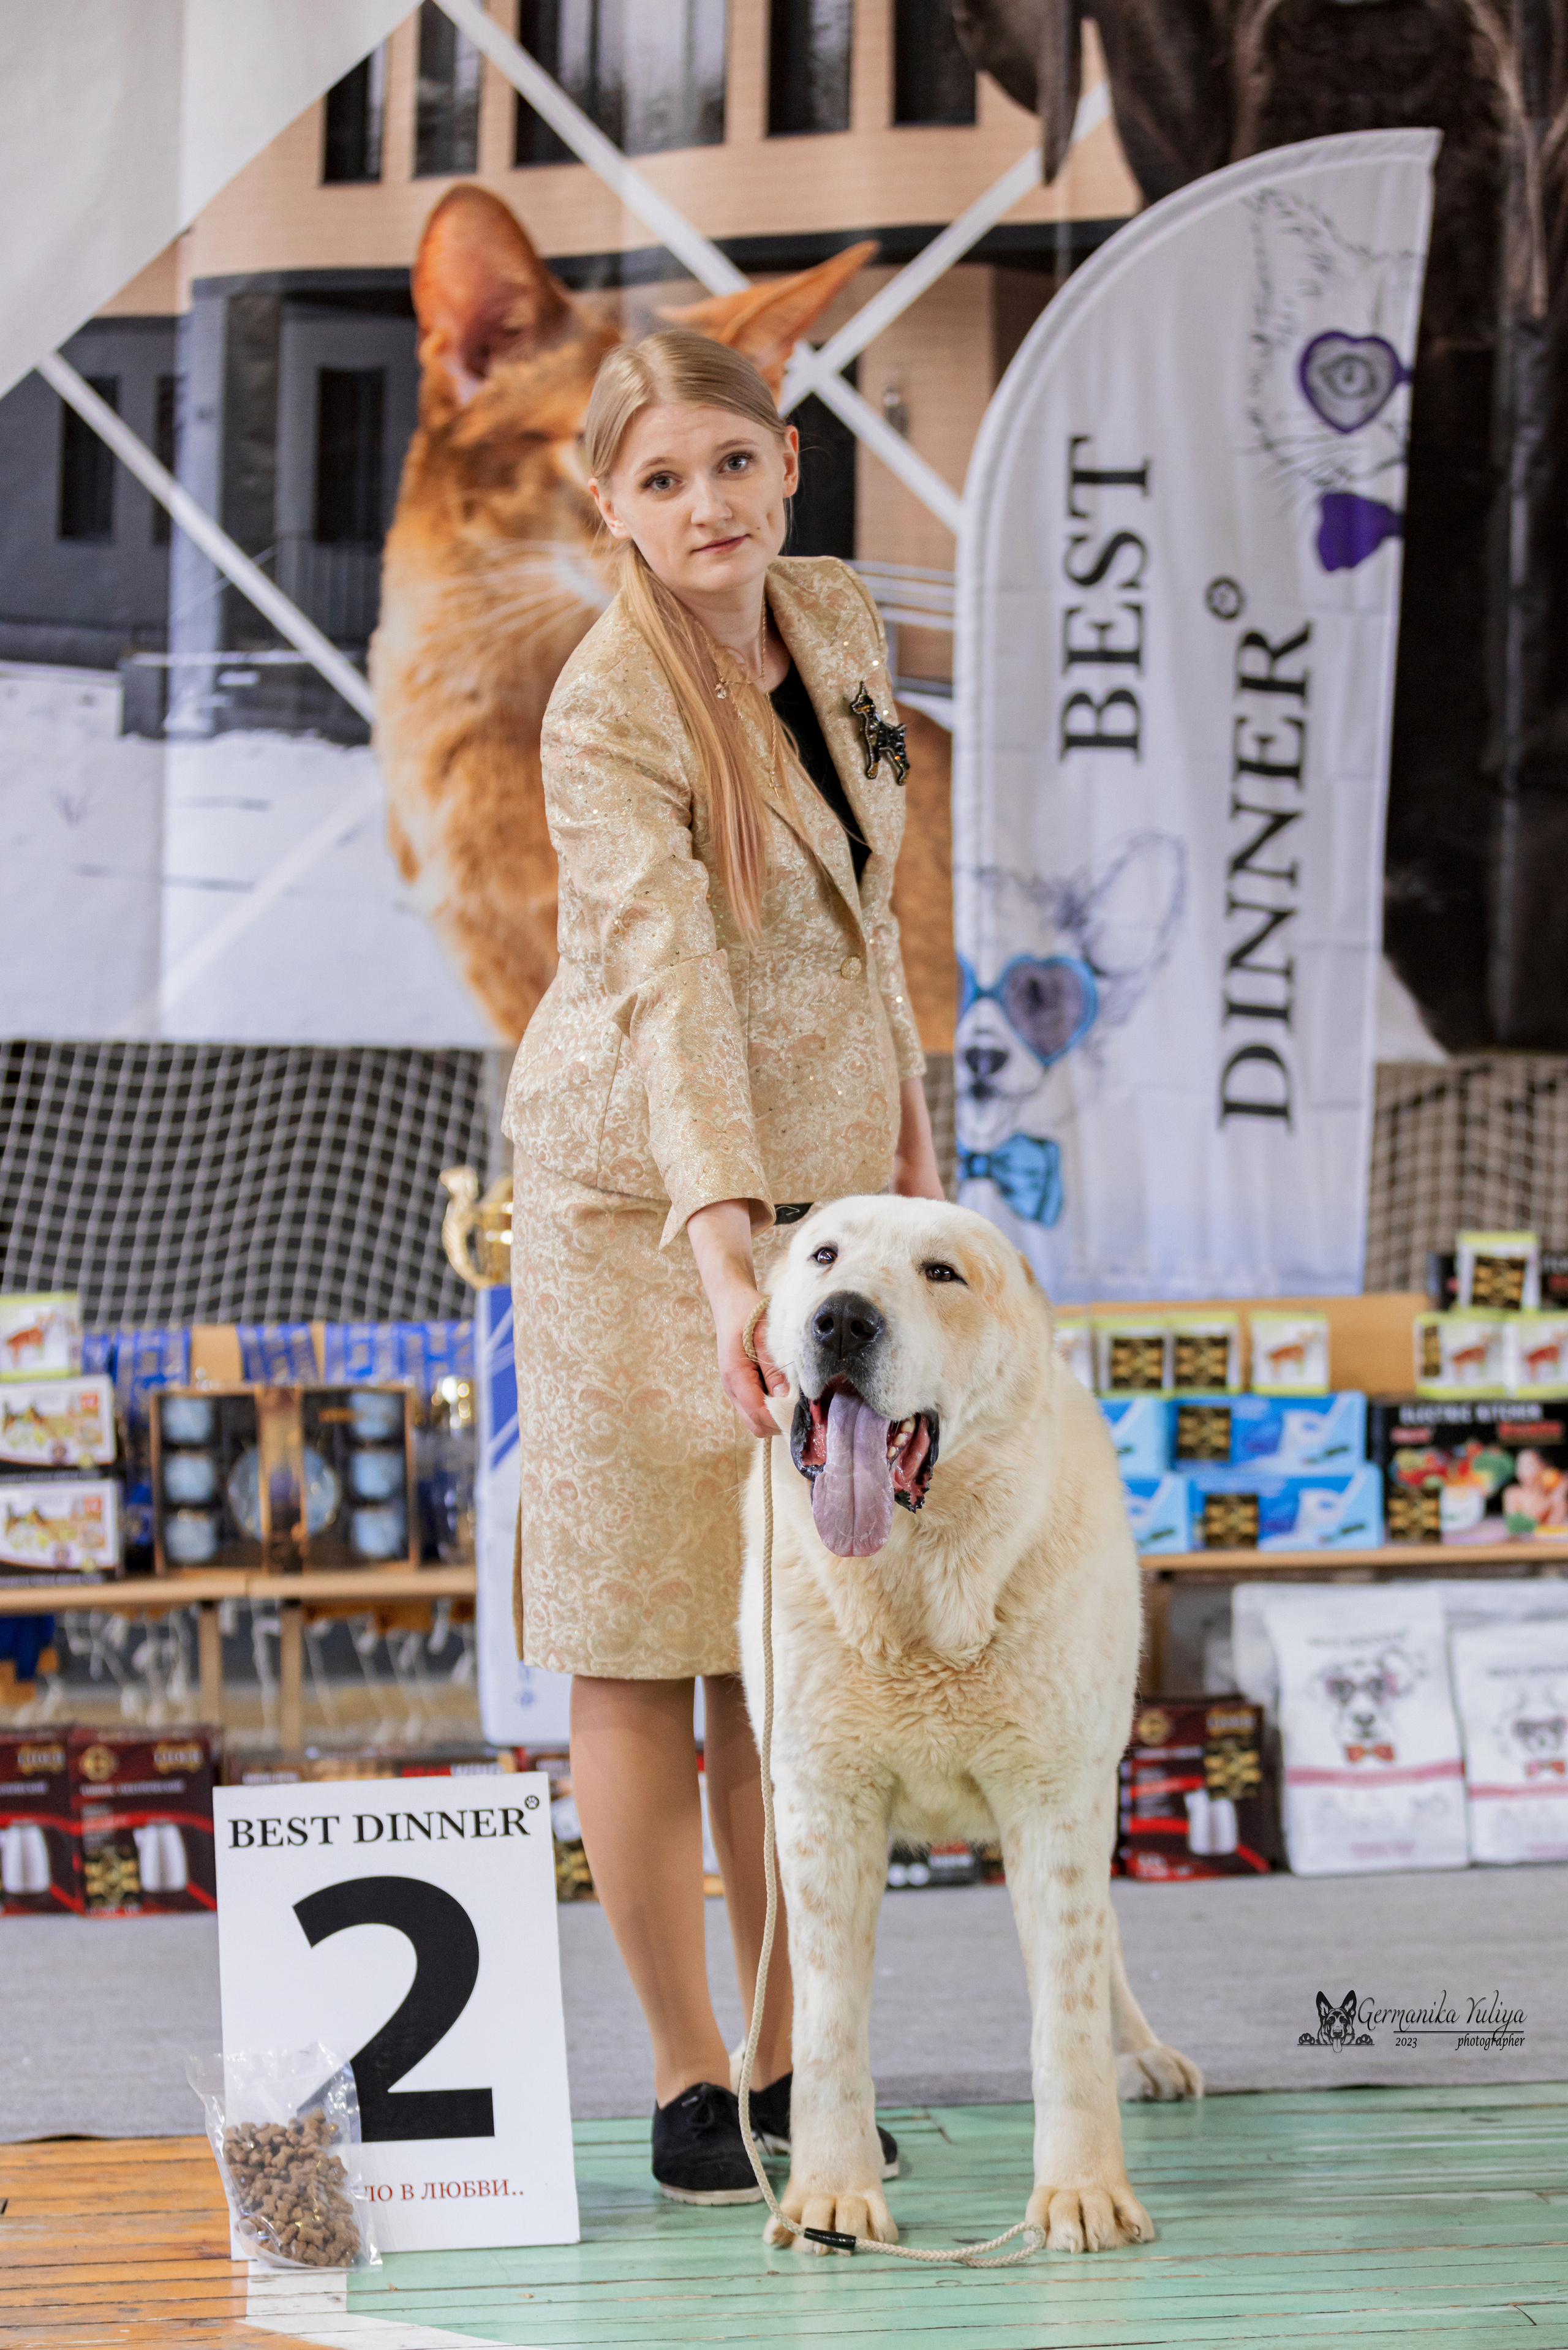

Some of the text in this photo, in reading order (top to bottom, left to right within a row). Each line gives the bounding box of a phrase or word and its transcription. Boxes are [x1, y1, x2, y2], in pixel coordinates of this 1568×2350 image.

[1060, 435, 1150, 763] BEST
[1219, 620, 1313, 1133] DINNER
[228, 1807, 530, 1848] BEST DINNER
[293, 1876, 495, 2143] 2
[364, 2185, 393, 2202] ЛО
[400, 2183, 415, 2201] В
